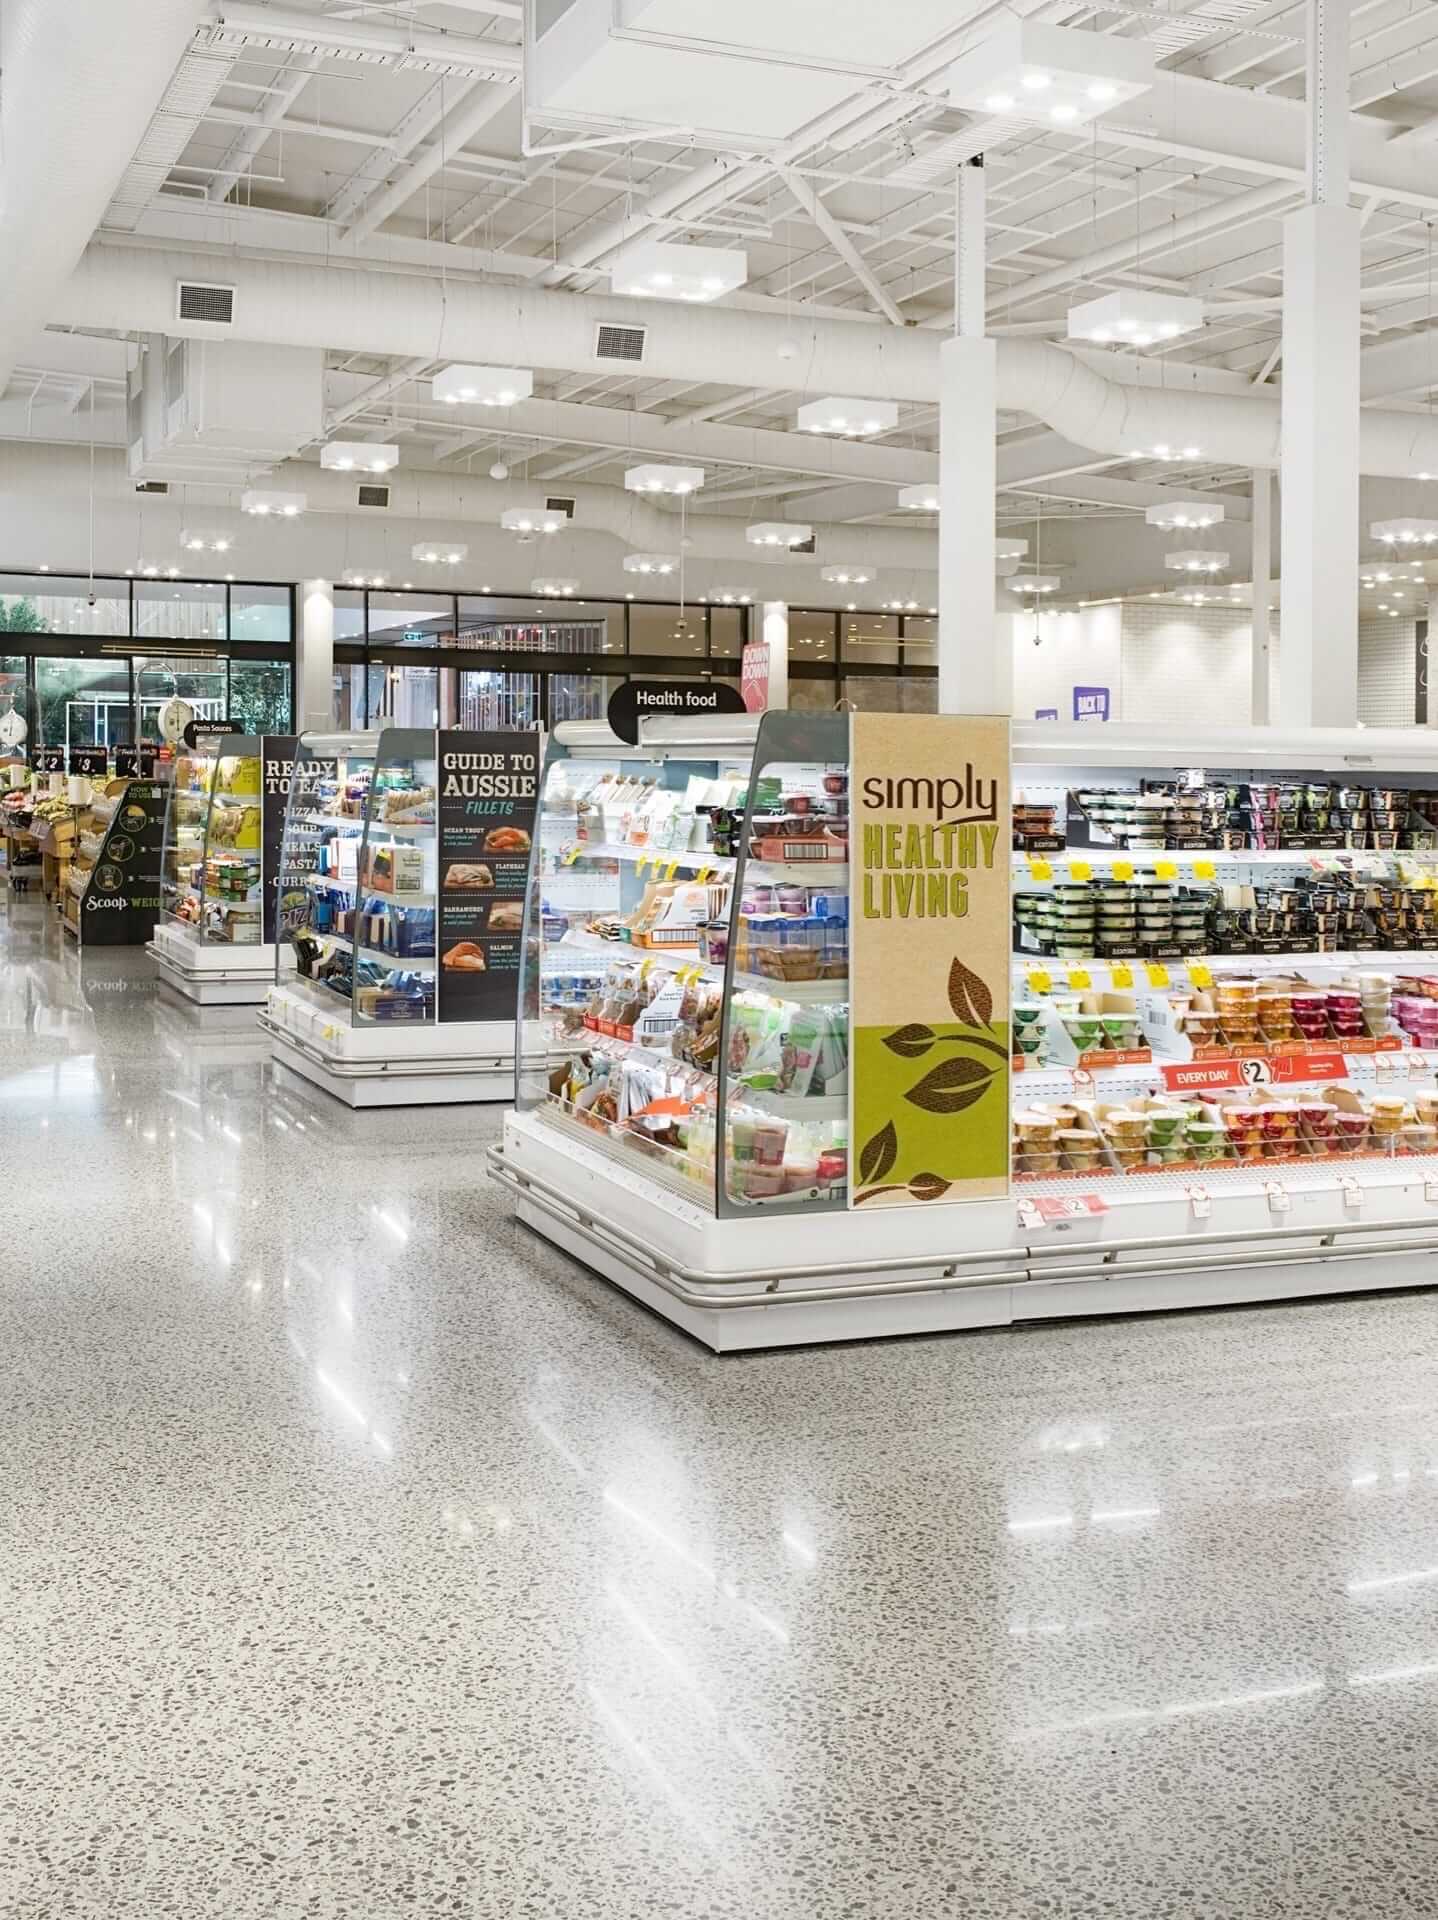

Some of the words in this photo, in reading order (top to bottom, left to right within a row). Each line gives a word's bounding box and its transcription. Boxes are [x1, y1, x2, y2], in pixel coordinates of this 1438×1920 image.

[744, 647, 769, 664] DOWN
[743, 663, 769, 680] DOWN
[636, 690, 683, 706] Health
[686, 691, 717, 707] food
[192, 724, 211, 732] Pasta
[211, 724, 233, 732] Sauces
[266, 760, 335, 777] READY
[443, 753, 504, 770] GUIDE
[510, 754, 536, 771] TO
[265, 778, 290, 794] TO
[298, 779, 322, 794] EA
[442, 775, 536, 797] AUSSIE
[862, 763, 997, 825] simply
[465, 800, 514, 816] FILLETS
[863, 823, 1000, 869] HEALTHY
[86, 895, 129, 911] Scoop
[863, 872, 970, 918] LIVING
[1176, 1072, 1208, 1085] EVERY
[1209, 1069, 1231, 1082] DAY
[1242, 1062, 1265, 1083] $2
